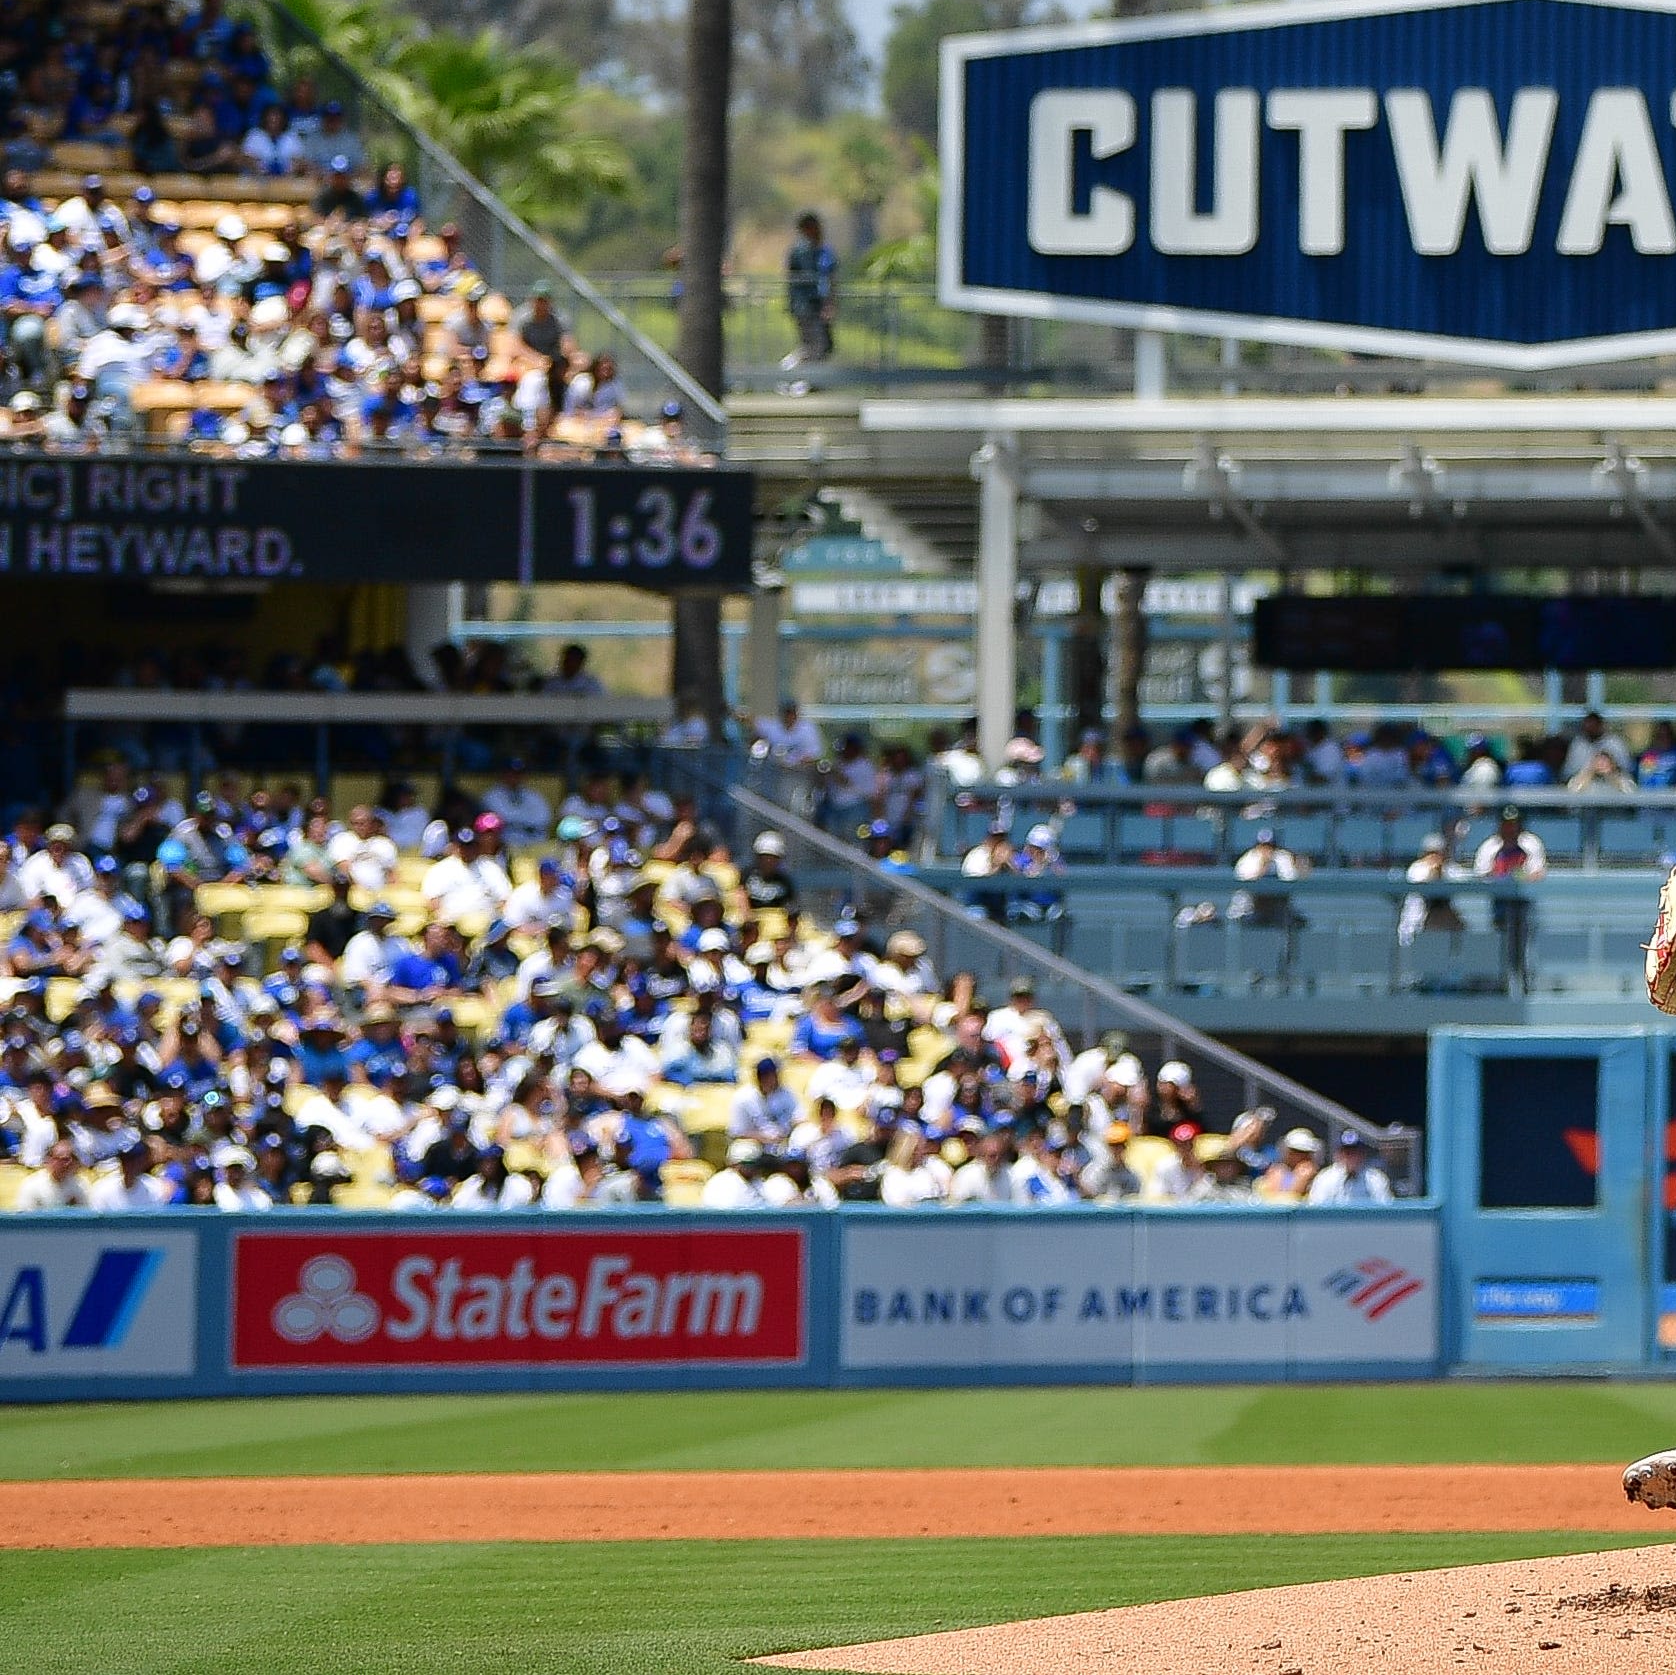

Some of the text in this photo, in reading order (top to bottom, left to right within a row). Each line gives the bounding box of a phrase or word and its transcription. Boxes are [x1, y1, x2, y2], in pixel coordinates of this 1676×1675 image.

[0, 464, 248, 518] IC] RIGHT
[26, 524, 303, 574] HEYWARD.
[568, 486, 722, 570] 1:36
[852, 1284, 1309, 1325] BANK OF AMERICA
